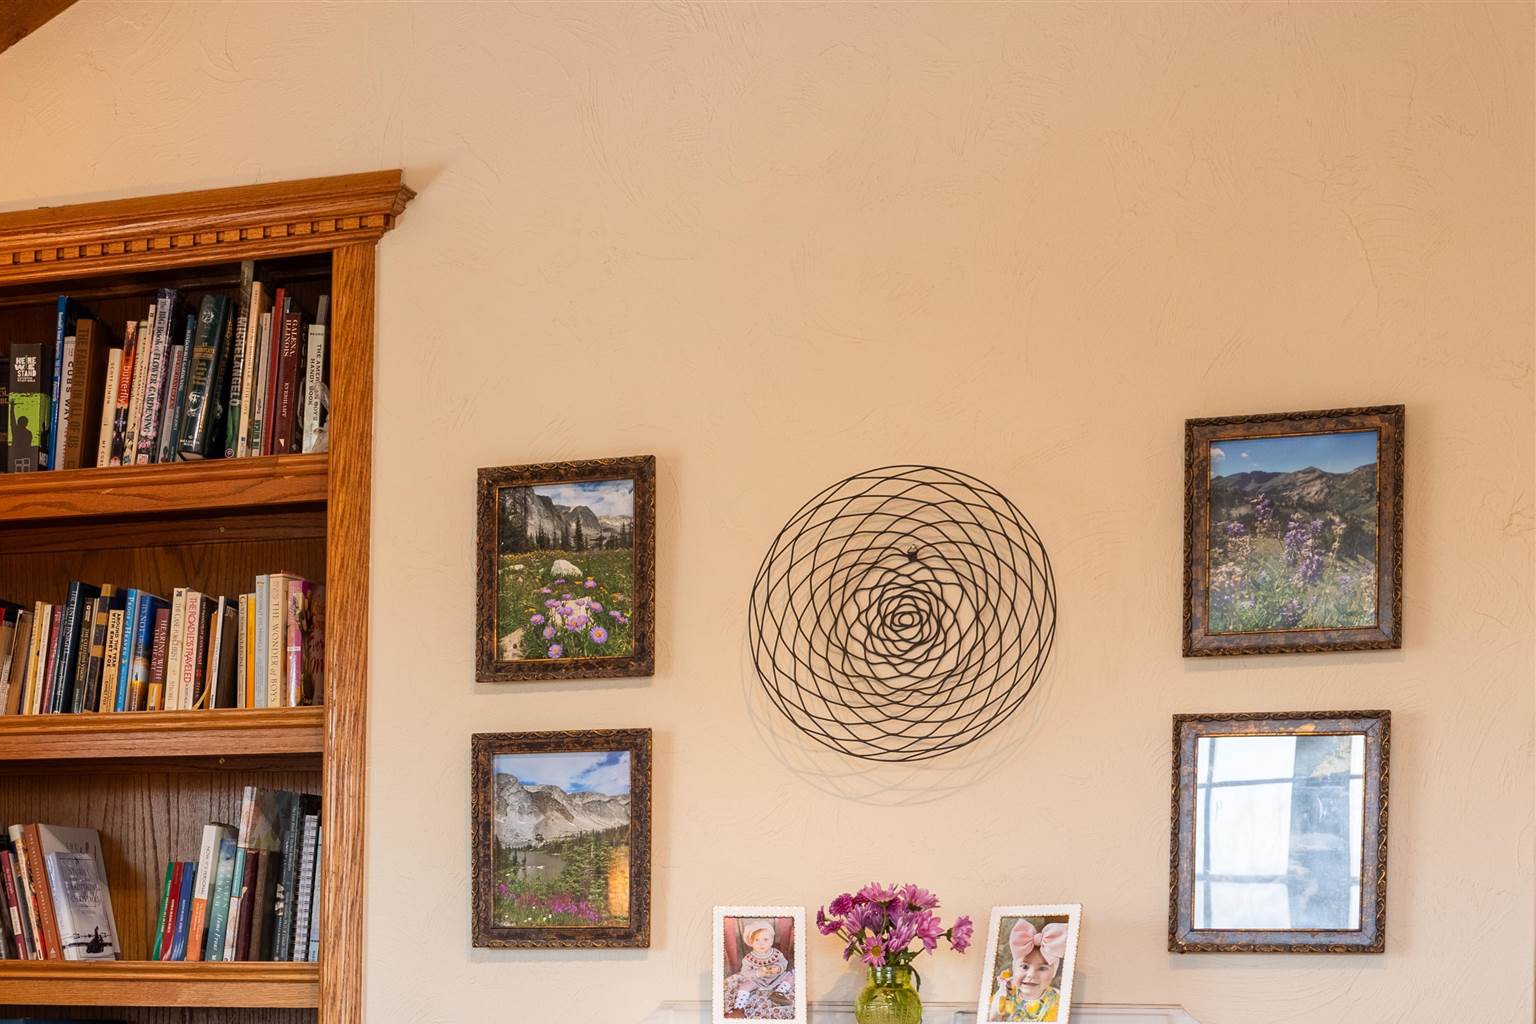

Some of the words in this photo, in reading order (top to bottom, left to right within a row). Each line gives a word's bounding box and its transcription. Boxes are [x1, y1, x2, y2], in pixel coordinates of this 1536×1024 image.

[157, 311, 166, 324] BIG
[78, 328, 90, 346] THE
[154, 326, 165, 346] Book
[283, 319, 292, 357] ILLINOIS
[16, 356, 37, 364] HERE
[148, 353, 161, 385] FLOWER
[229, 316, 248, 407] MICHELANGELO
[65, 361, 74, 393] CUBS
[117, 365, 131, 405] butterfly
[144, 386, 157, 433] GARDENING
[187, 611, 195, 634] ROAD
[272, 601, 280, 619] THE
[139, 615, 148, 632] NOT
[158, 620, 168, 657] HEARING
[186, 635, 194, 648] LESS
[271, 623, 280, 667] WONDER
[151, 645, 159, 672] HEART
[156, 659, 164, 680] WITH
[183, 648, 194, 684] TRAVELED
[270, 678, 279, 703] BOYS
[200, 870, 209, 895] PERSONAL
[215, 913, 223, 933] Home
[212, 933, 221, 951] Front
